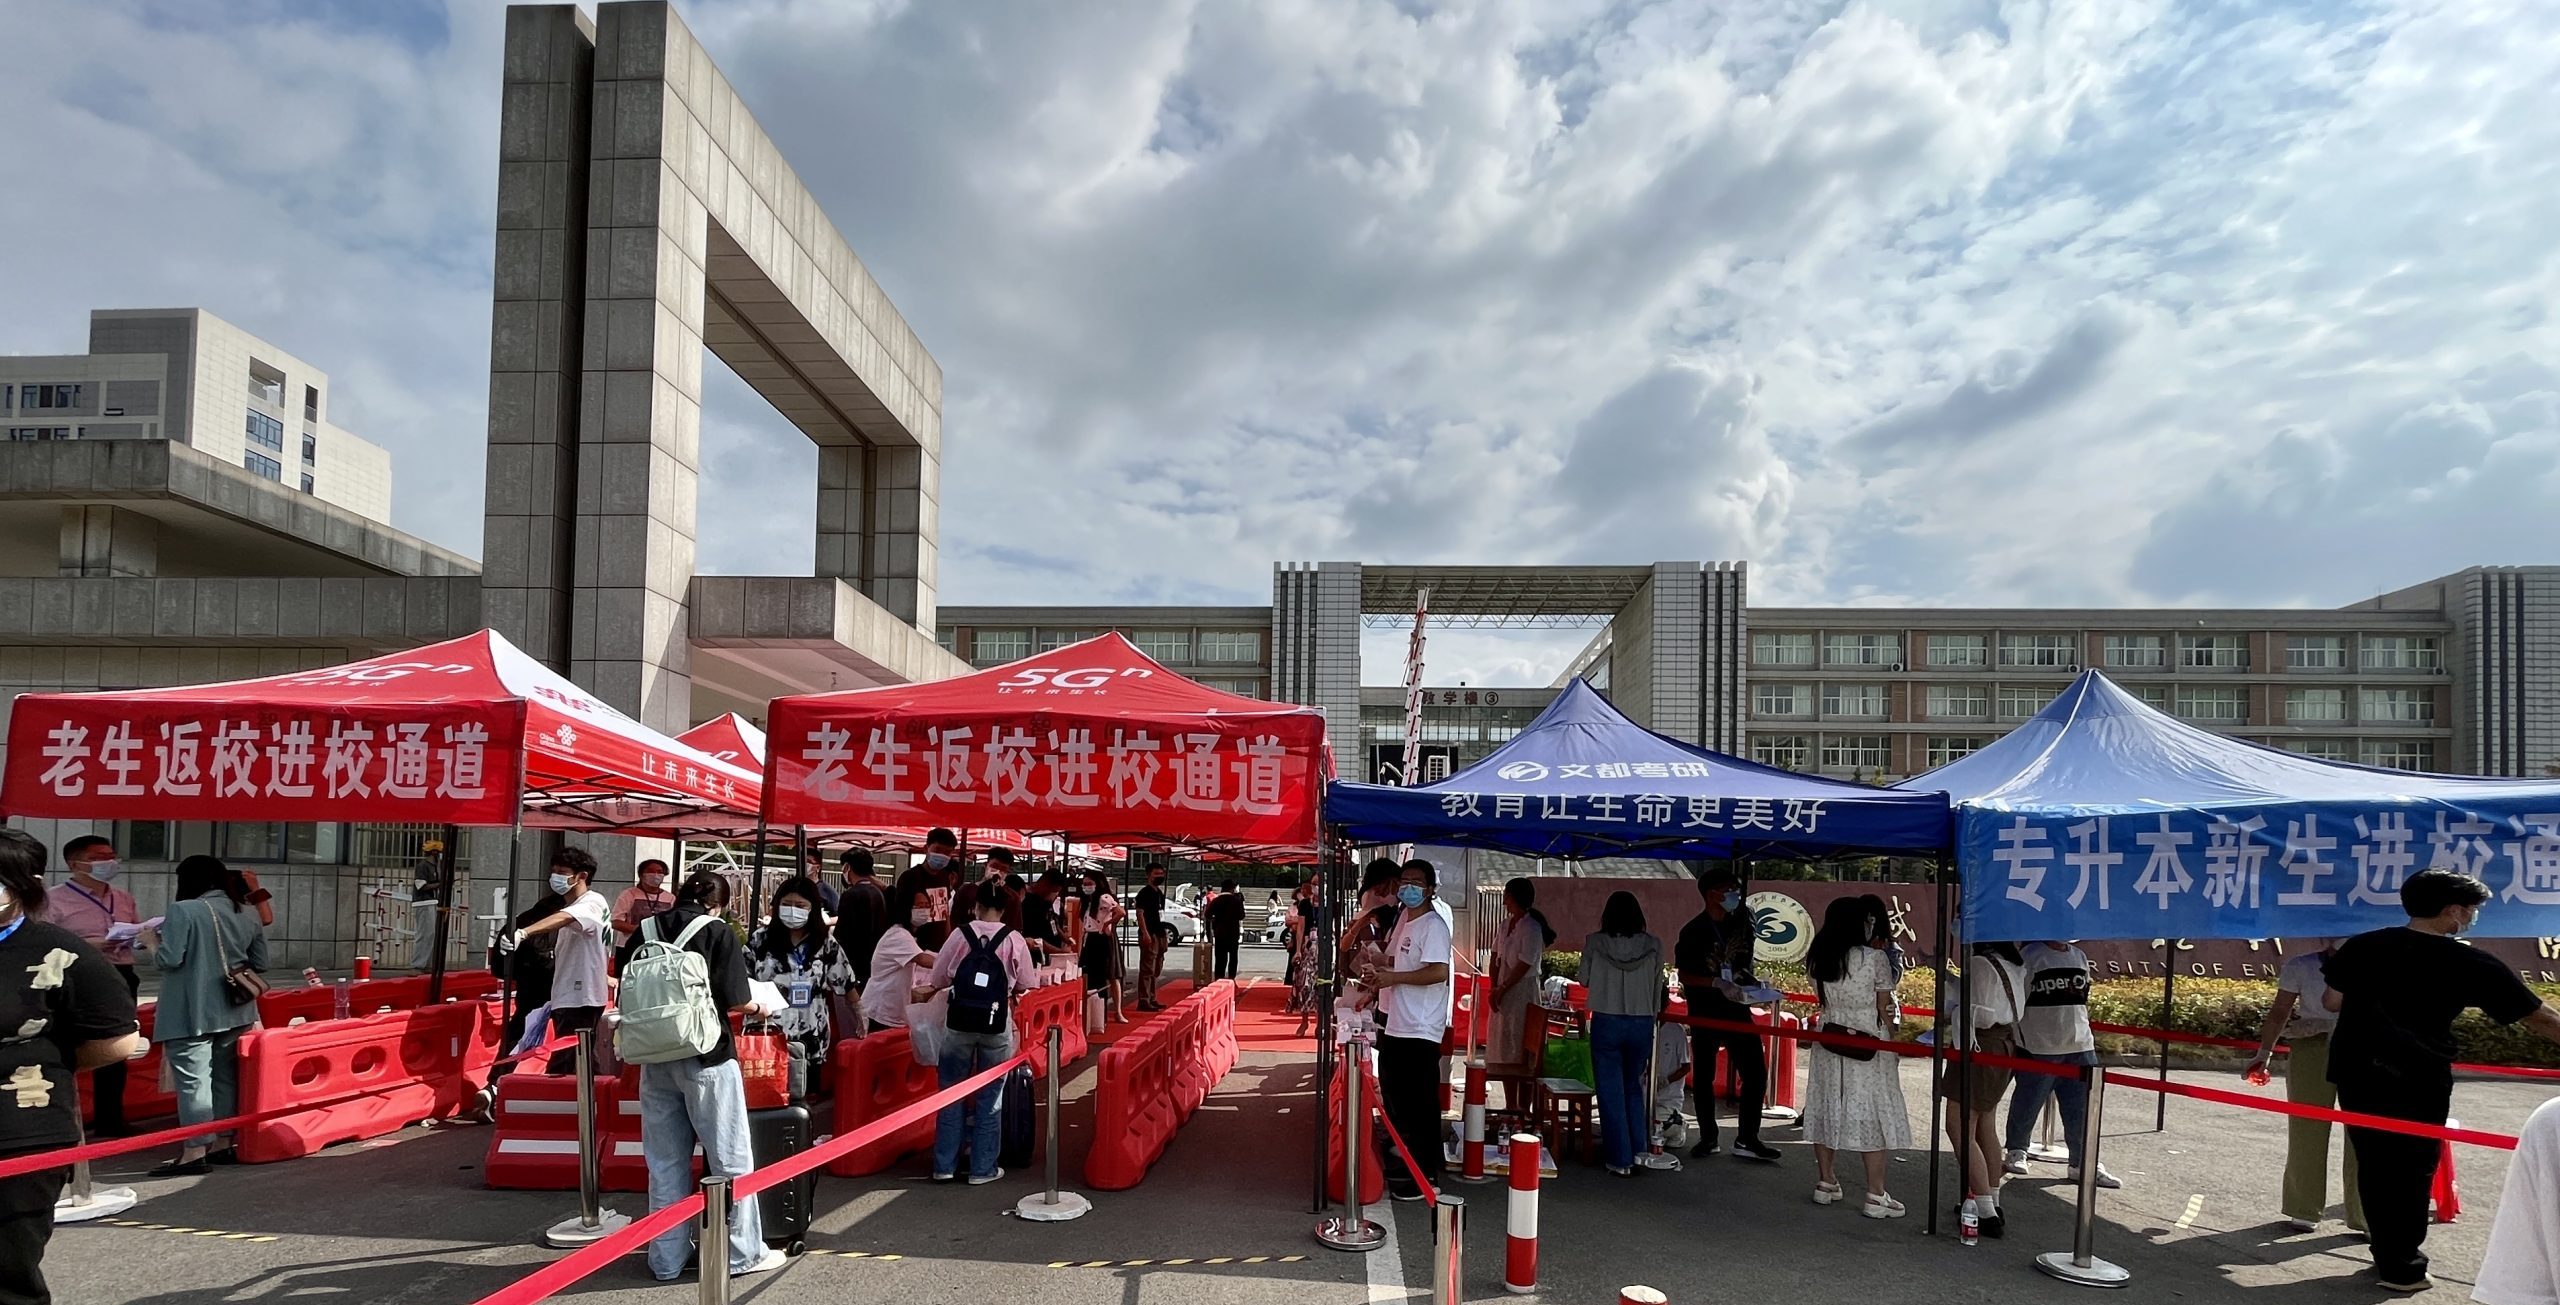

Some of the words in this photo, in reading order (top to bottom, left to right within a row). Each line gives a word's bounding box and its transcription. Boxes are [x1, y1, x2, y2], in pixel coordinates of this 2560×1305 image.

[40, 719, 489, 799] 老生返校进校通道
[641, 751, 736, 800] 让未来生长
[802, 721, 1286, 816] 老生返校进校通道
[1559, 762, 1710, 779] 文都考研
[1440, 791, 1828, 834] 教育让生命更美好
[2191, 962, 2224, 976] OF
